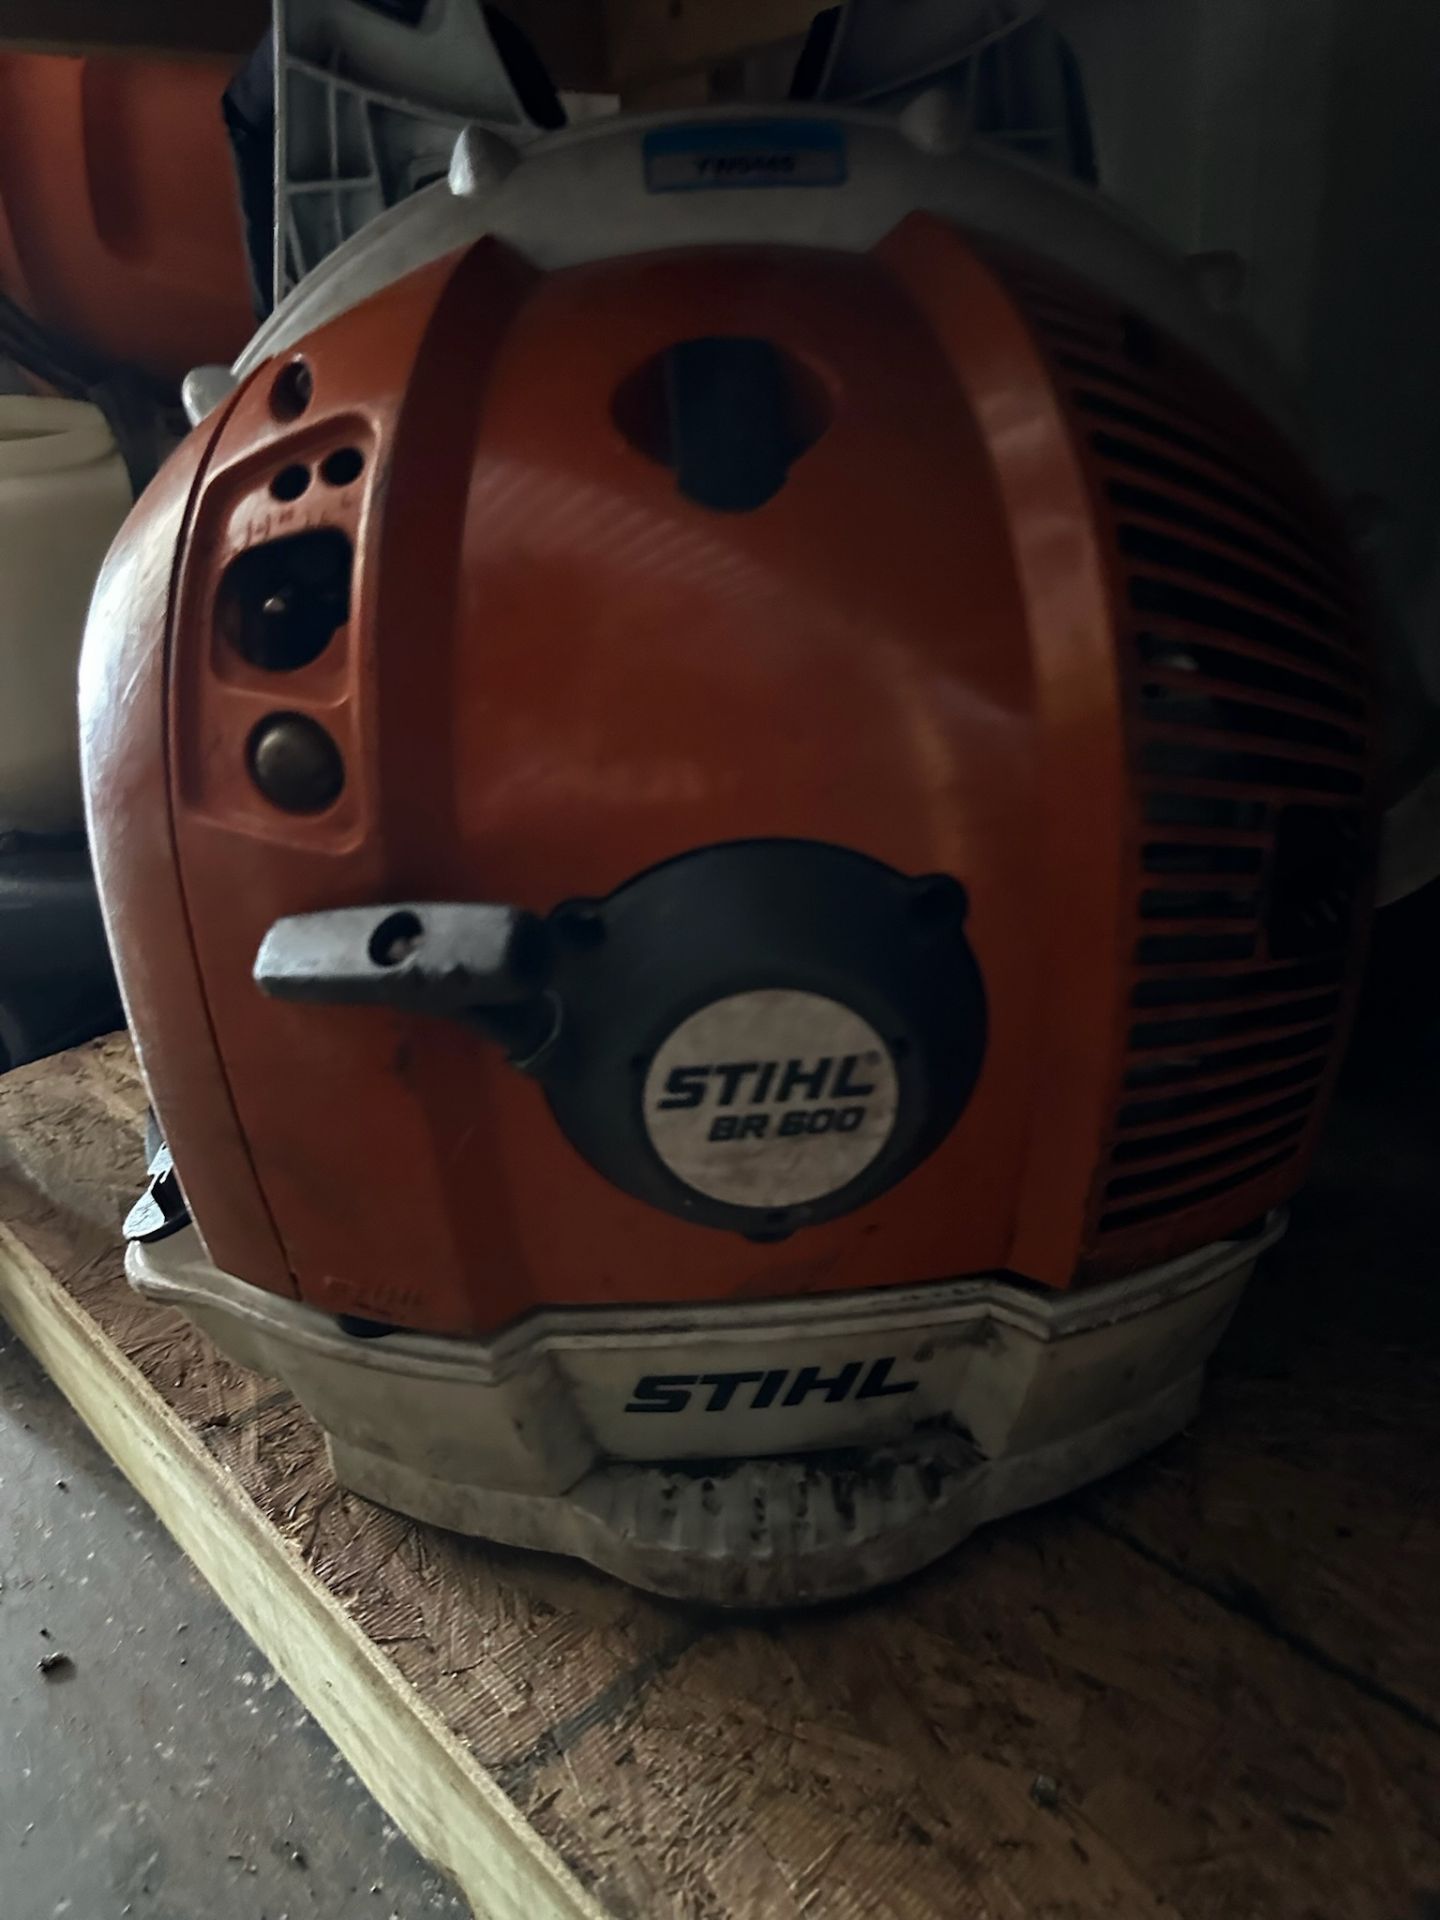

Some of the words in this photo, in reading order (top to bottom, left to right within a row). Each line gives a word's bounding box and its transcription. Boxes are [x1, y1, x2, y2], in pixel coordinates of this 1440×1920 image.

[657, 1055, 877, 1109] STIHL
[709, 1114, 769, 1141] BR
[777, 1107, 865, 1136] 600
[624, 1357, 918, 1412] STIHL
